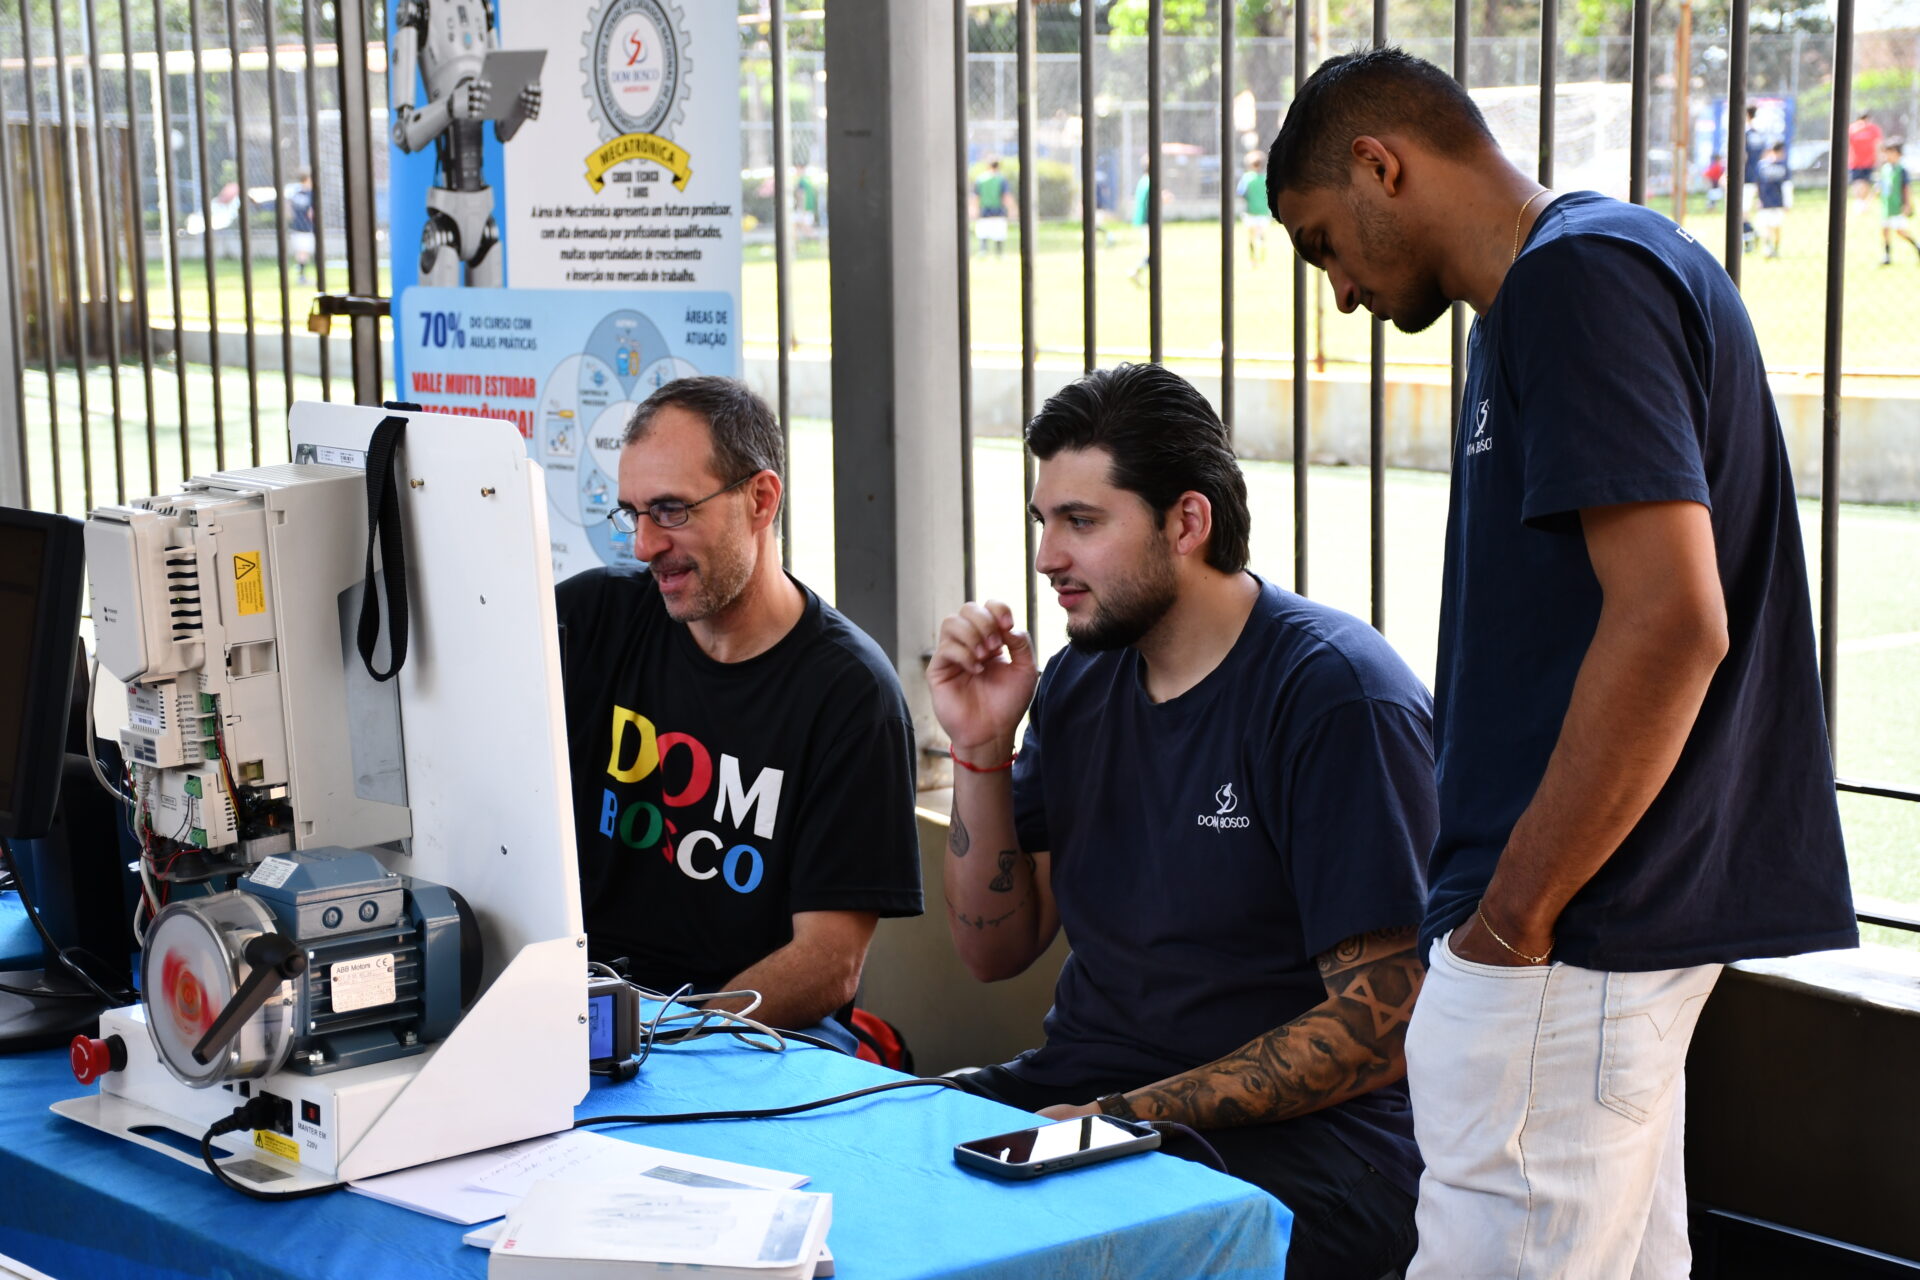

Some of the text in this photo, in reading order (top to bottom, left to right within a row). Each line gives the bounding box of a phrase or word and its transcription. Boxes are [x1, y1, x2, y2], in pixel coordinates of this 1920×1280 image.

[599, 137, 676, 166] MECATRÔNICA
[555, 205, 563, 218] de
[565, 205, 611, 218] Mecatrônica
[613, 206, 650, 219] apresenta
[652, 207, 662, 217] um
[664, 204, 689, 217] futuro
[691, 203, 733, 218] promissor,
[541, 225, 722, 241] com alta demanda por profissionais qualificados,
[560, 247, 702, 262] muitas oportunidades de crescimento
[572, 268, 604, 283] inserção
[606, 271, 615, 281] no
[617, 268, 649, 281] mercado
[651, 268, 659, 281] de
[660, 267, 696, 282] trabalho.
[469, 315, 533, 330] DO CURSO COM
[685, 305, 728, 325] ÁREAS DE
[419, 311, 466, 349] 70%
[469, 333, 538, 351] AULAS PRÁTICAS
[685, 329, 728, 350] ATUAÇÃO
[412, 371, 536, 399] VALE MUITO ESTUDAR
[595, 437, 622, 450] MECA
[607, 704, 784, 840] DOM
[1198, 814, 1250, 829] DOM BOSCO
[599, 788, 764, 894] BOSCO
[336, 963, 350, 974] ABB
[350, 961, 371, 972] Motors
[297, 1122, 327, 1140] MANTER EM
